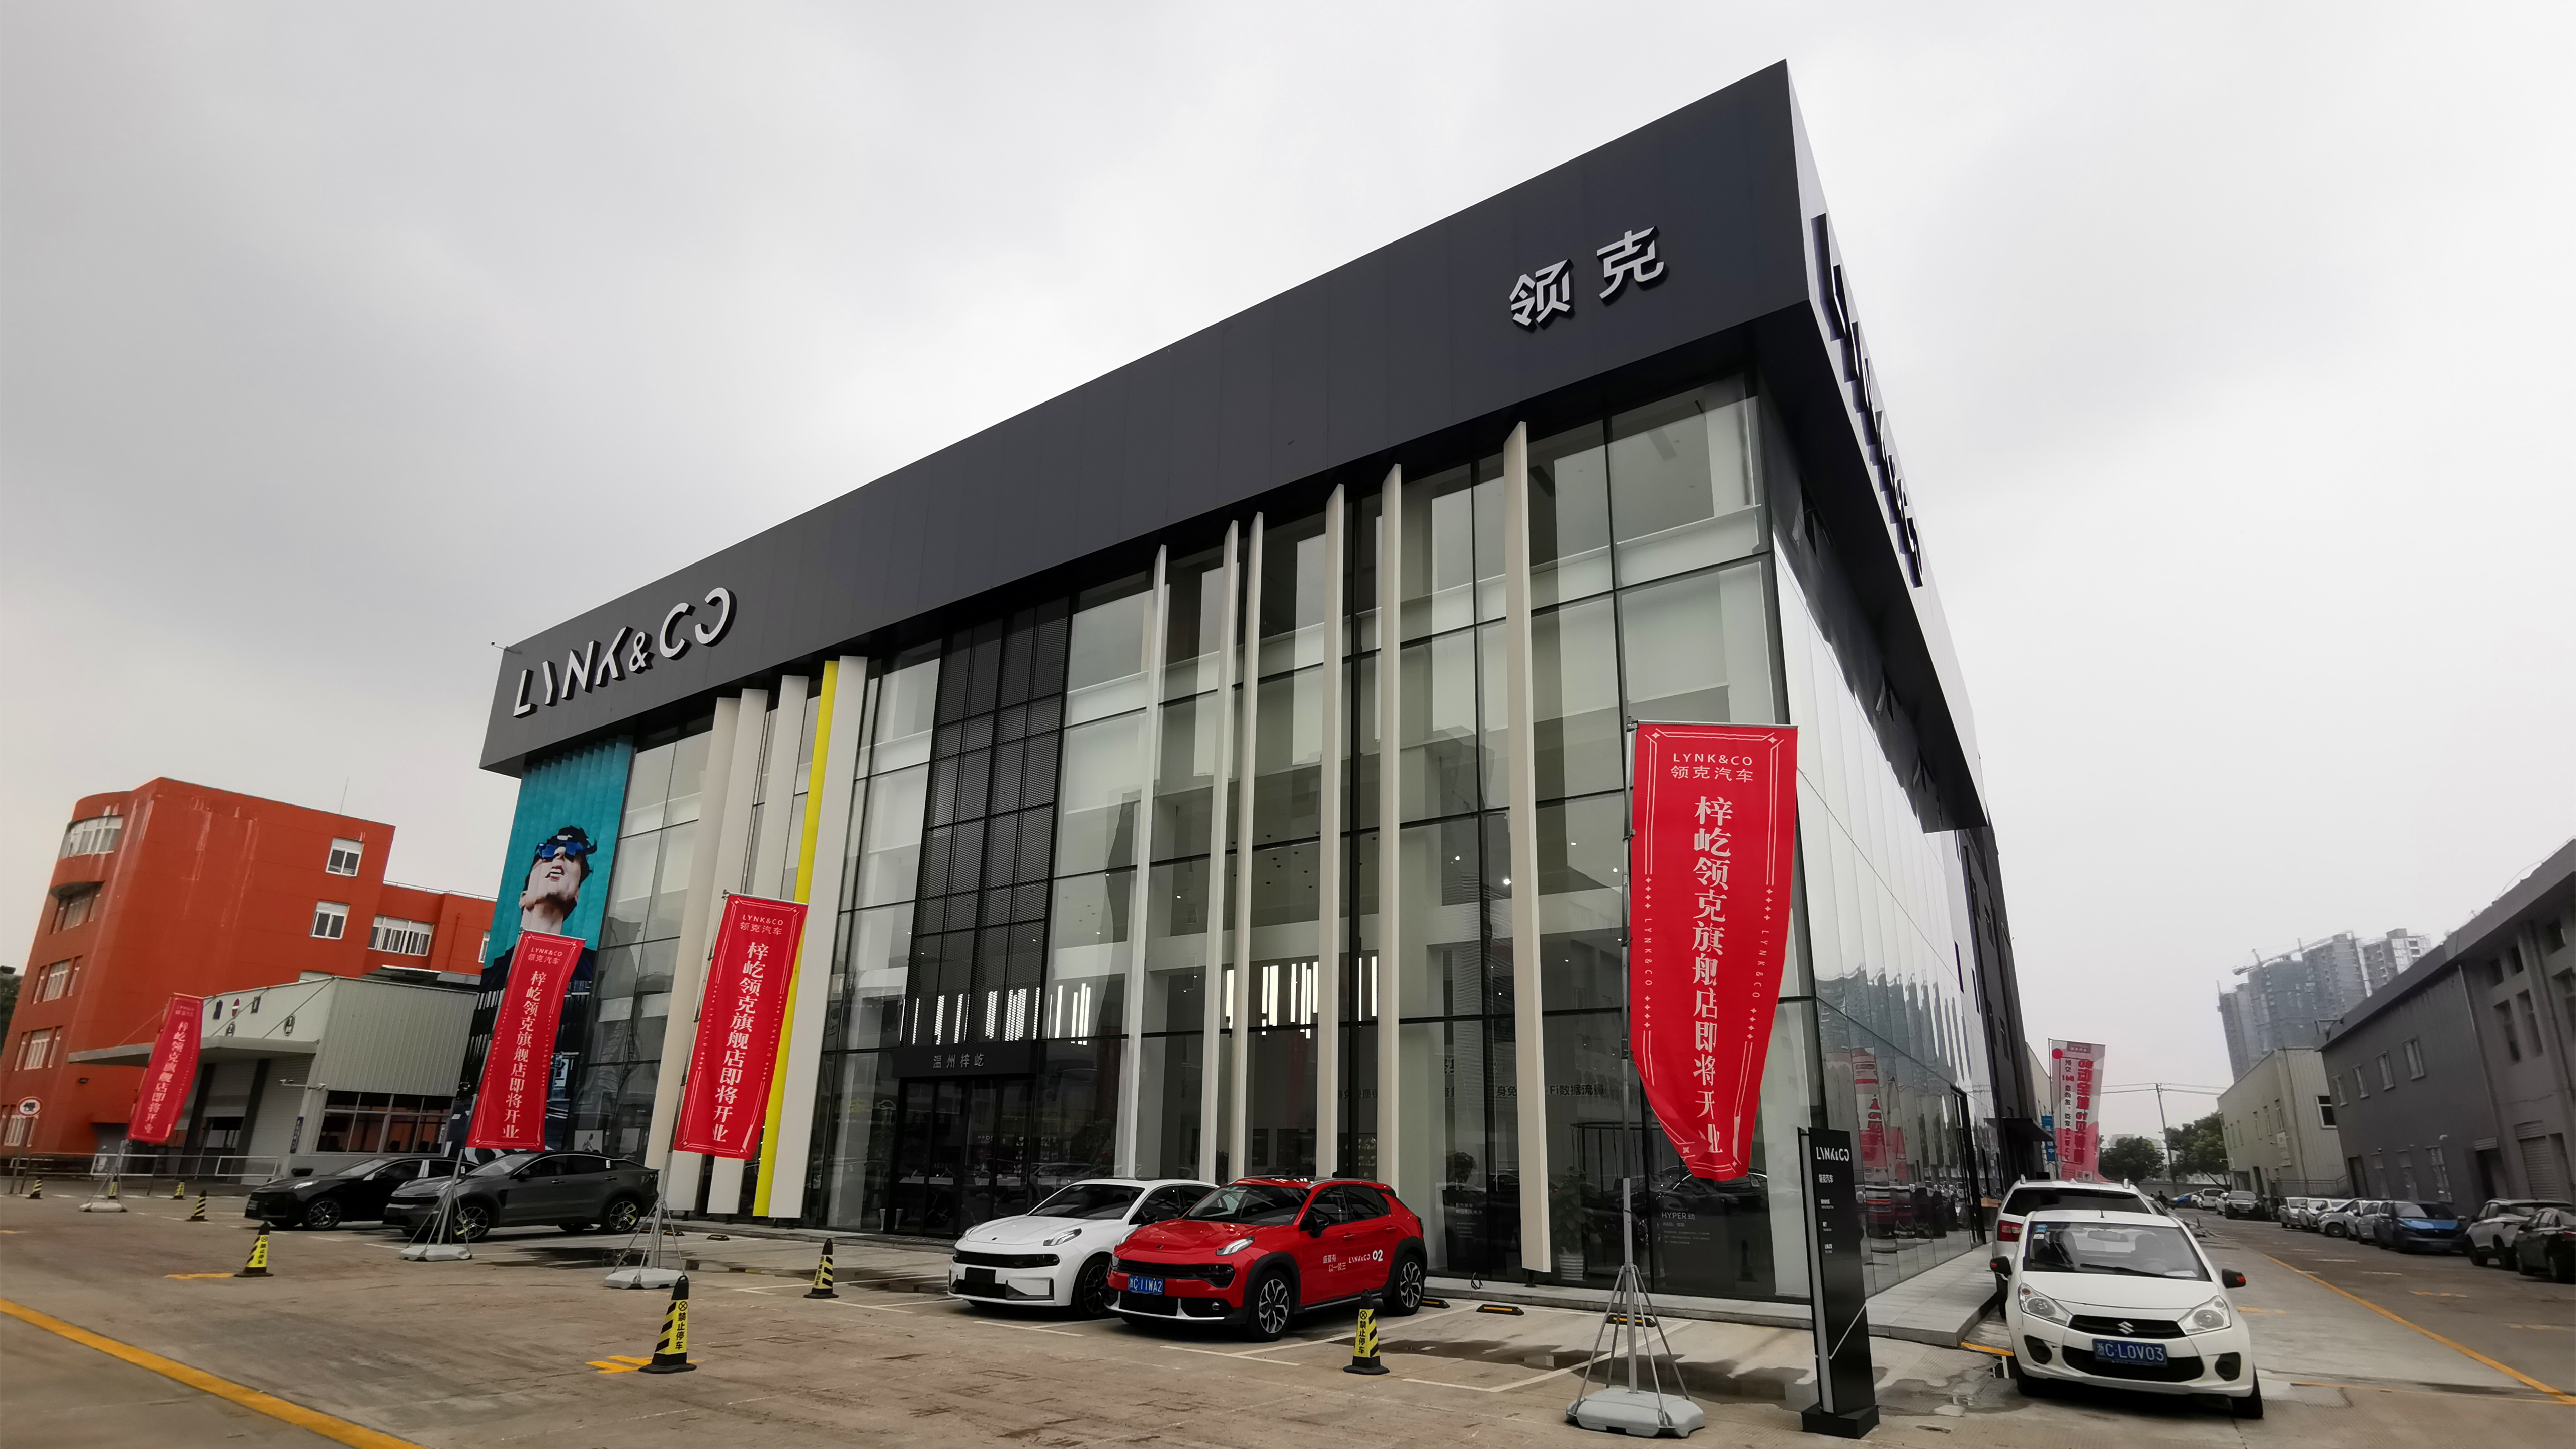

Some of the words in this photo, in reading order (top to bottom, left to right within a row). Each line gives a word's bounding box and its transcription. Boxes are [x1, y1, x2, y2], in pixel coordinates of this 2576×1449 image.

[1509, 225, 1664, 326] 领克
[1673, 753, 1753, 766] LYNK&CO
[1671, 765, 1754, 783] 领克汽车
[740, 921, 783, 936] 领克汽车
[742, 914, 783, 926] LYNK&CO
[528, 952, 561, 965] 领克汽车
[530, 947, 563, 957] LYNK&CO
[1644, 918, 1653, 986] LYNK&CO
[1752, 930, 1769, 998] LYNK&CO
[1692, 796, 1733, 1154] 梓屹领克旗舰店即将开业
[711, 942, 769, 1143] 梓屹领克旗舰店即将开业
[501, 971, 547, 1139] 梓屹领克旗舰店即将开业
[933, 1053, 984, 1068] 温州梓屹
[1661, 1211, 1687, 1220] HYPER
[1372, 1249, 1383, 1262] 02
[675, 1312, 686, 1350] 禁止停车
[1358, 1320, 1366, 1354] 禁止停车
